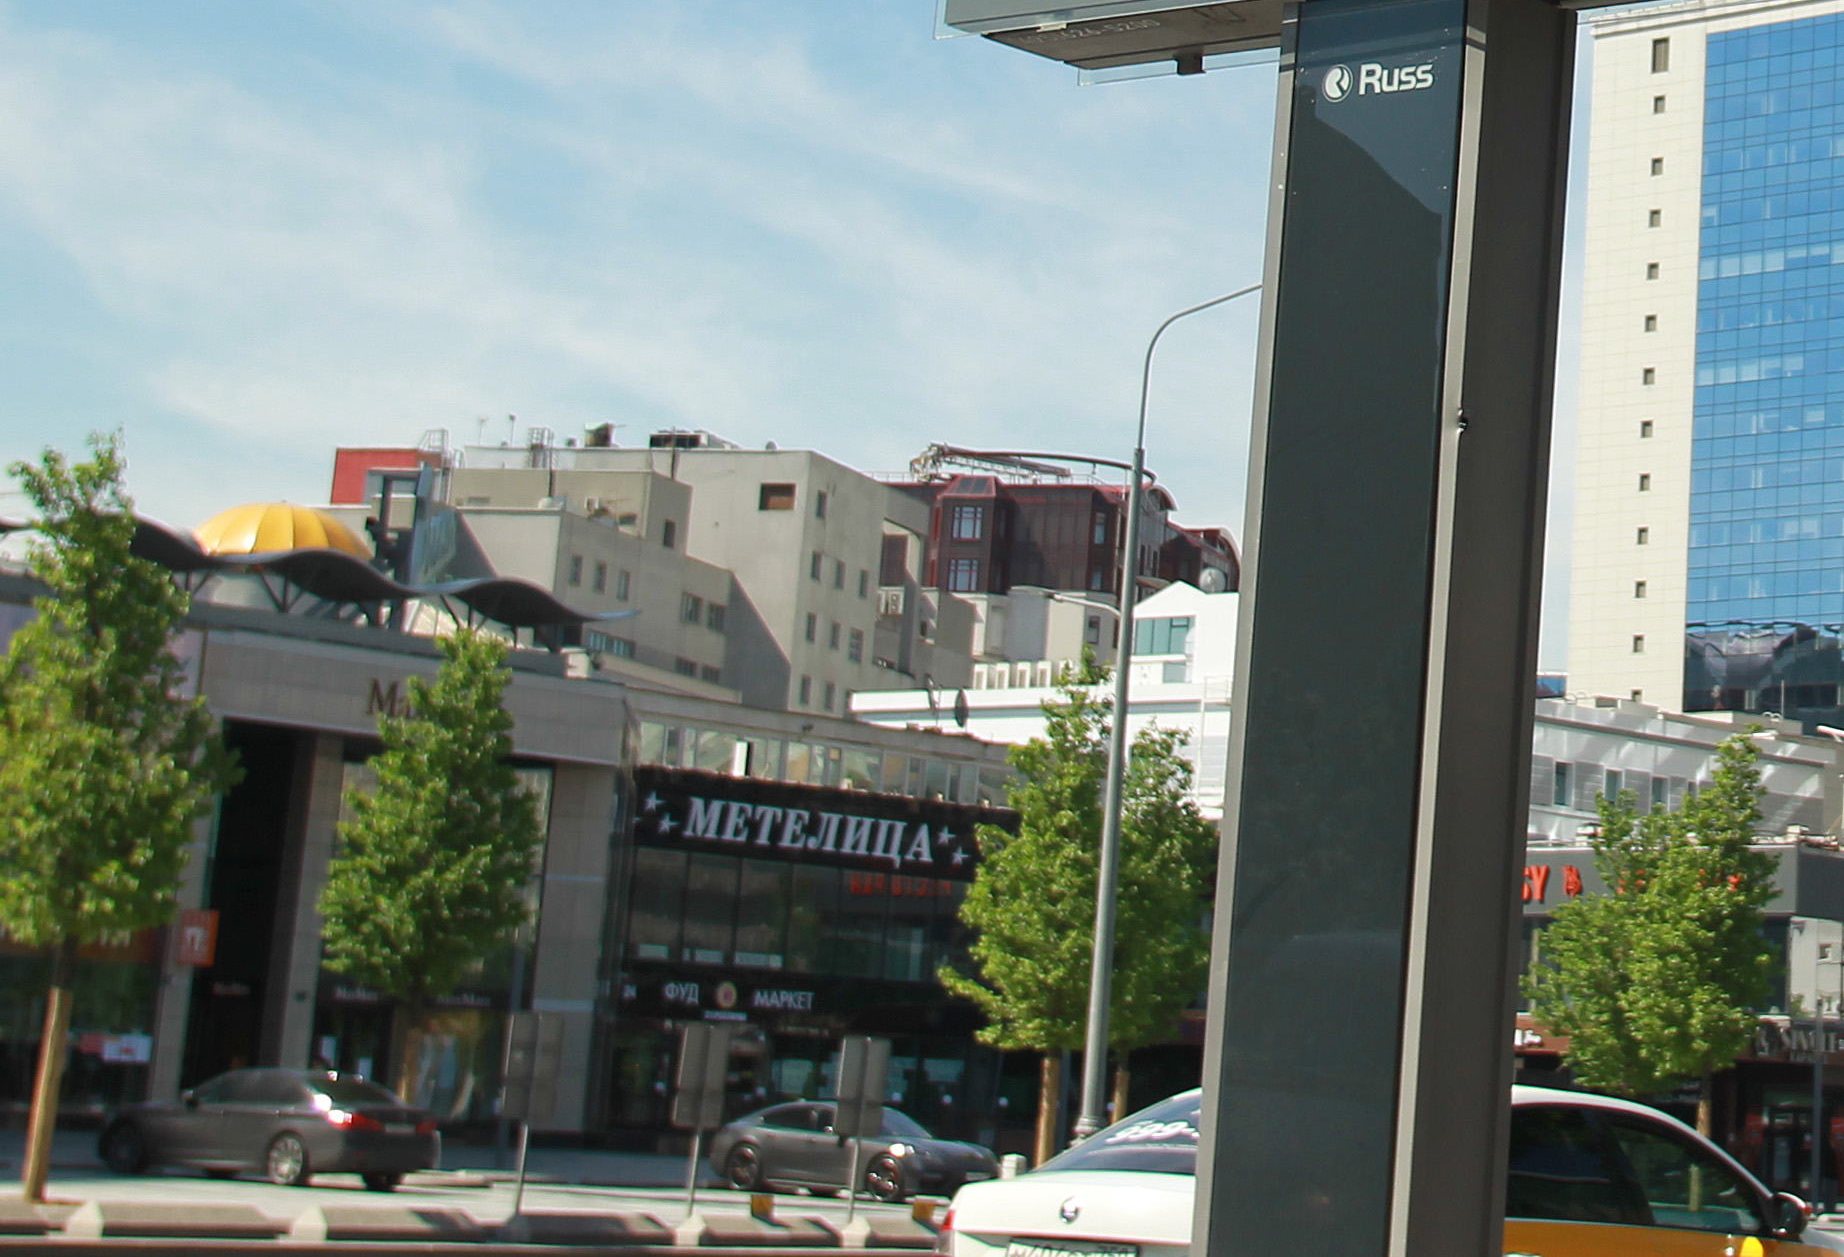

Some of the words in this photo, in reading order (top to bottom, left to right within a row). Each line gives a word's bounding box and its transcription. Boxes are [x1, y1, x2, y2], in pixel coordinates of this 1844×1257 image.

[1358, 62, 1434, 96] Russ
[682, 796, 934, 869] МЕТЕЛИЦА
[664, 982, 700, 1005] ФУД
[753, 989, 815, 1011] МАРКЕТ
